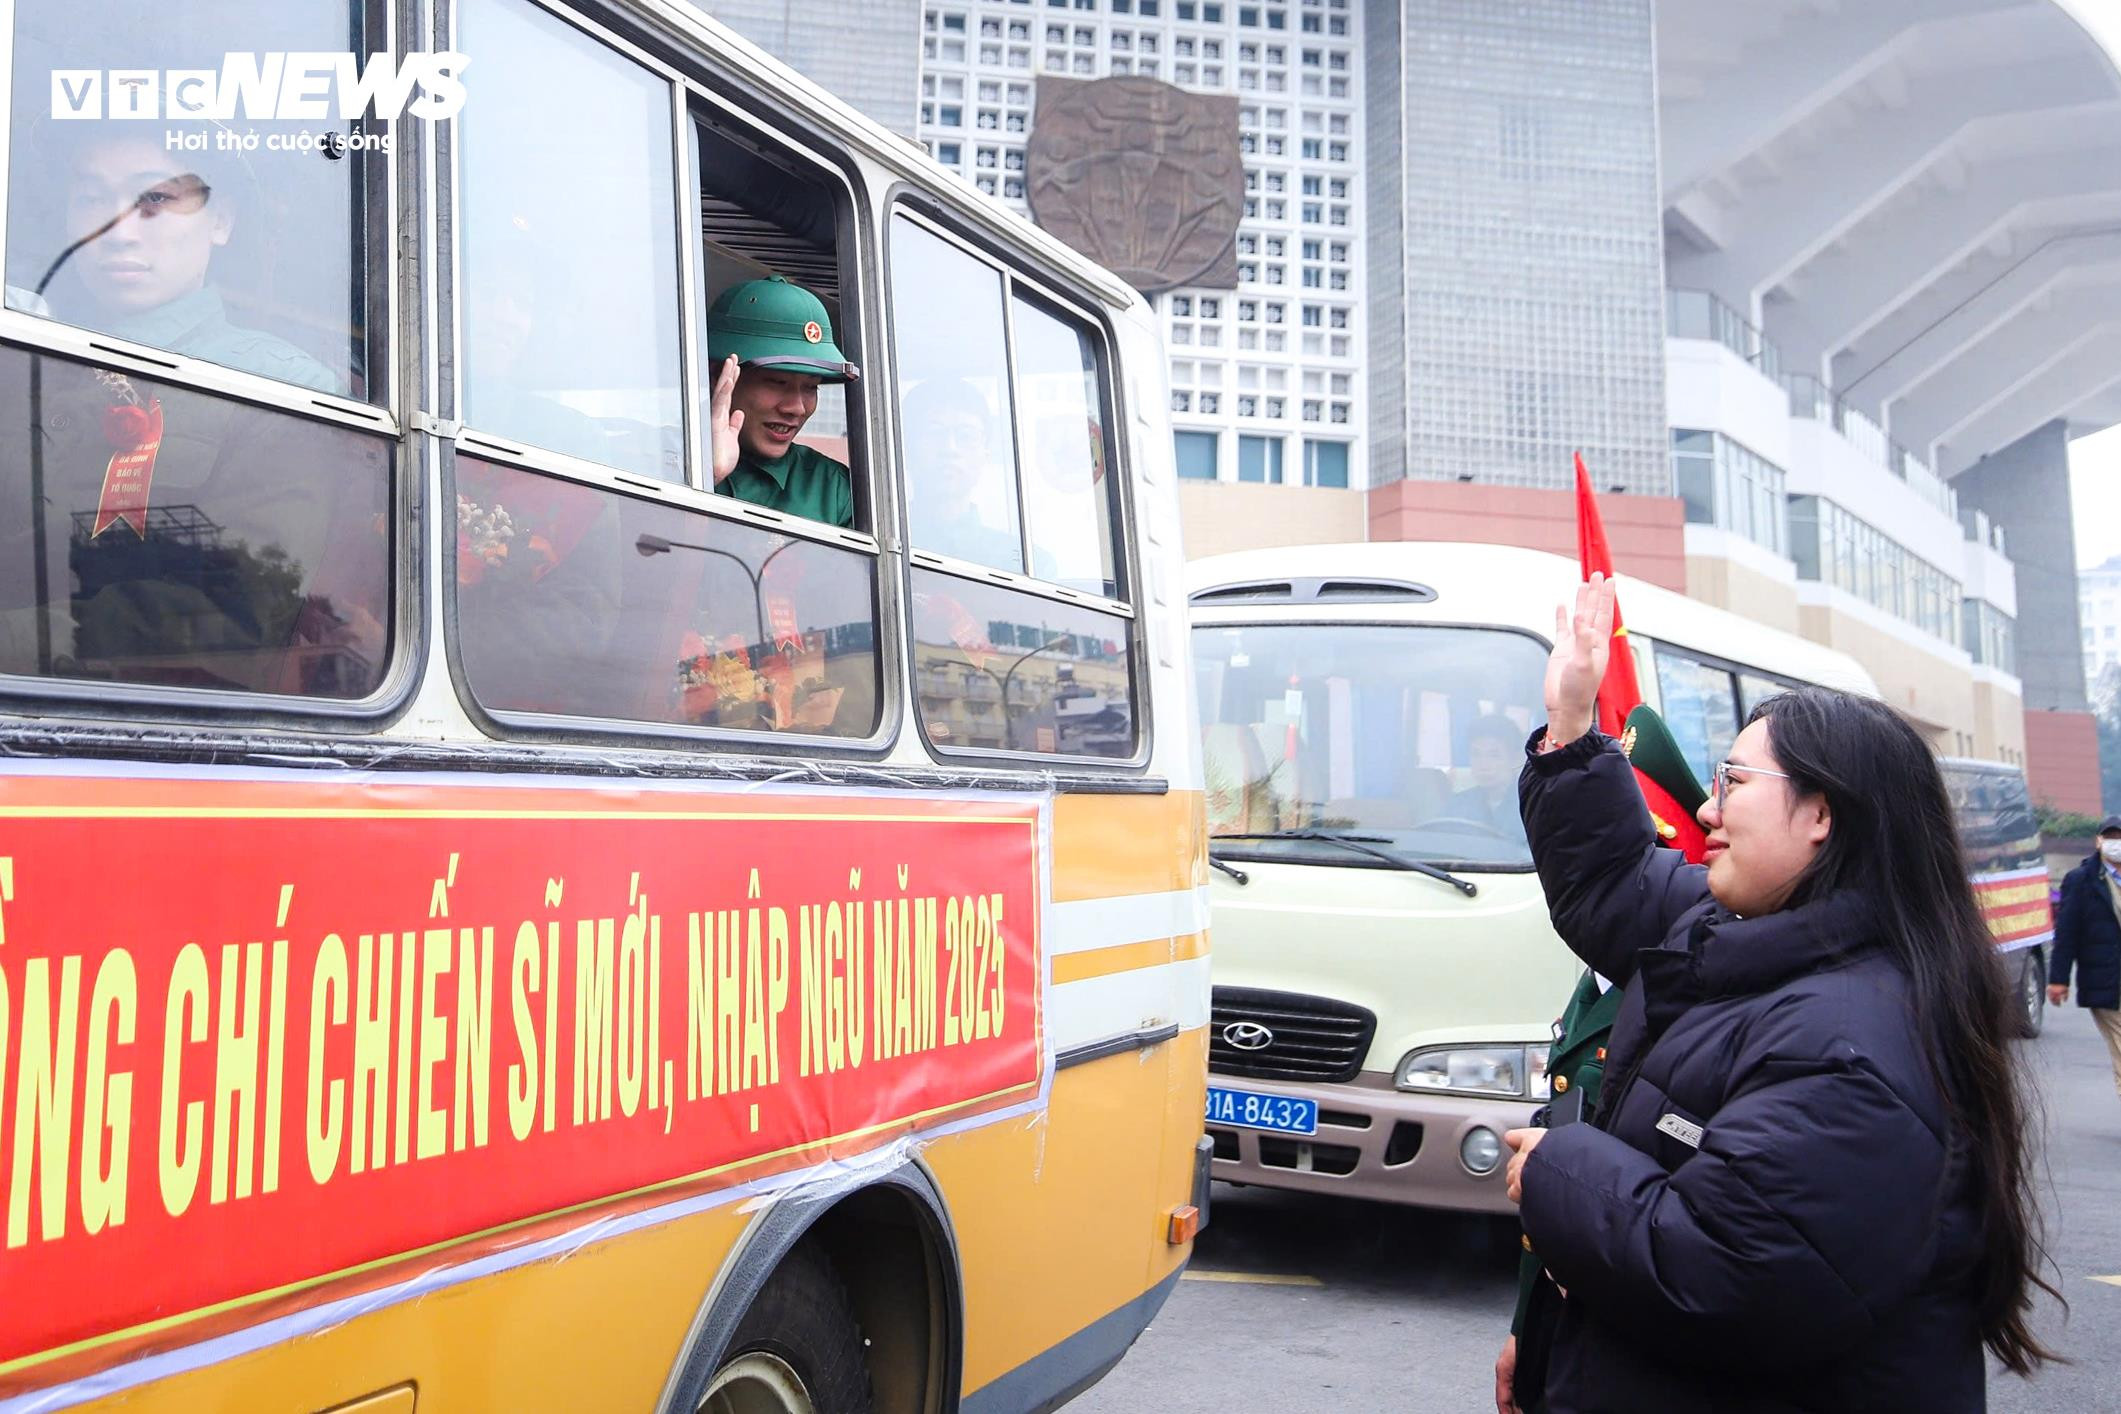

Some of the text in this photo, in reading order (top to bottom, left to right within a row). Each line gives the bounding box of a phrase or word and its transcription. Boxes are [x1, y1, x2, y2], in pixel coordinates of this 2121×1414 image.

[159, 885, 295, 1217] CHÍ
[307, 853, 495, 1185] CHIẾN
[509, 877, 563, 1141] SĨ
[574, 872, 673, 1135] MỚI,
[688, 868, 789, 1133] NHẬP
[800, 867, 865, 1077] NGŨ
[874, 864, 937, 1061] NĂM
[944, 893, 1005, 1047] 2025
